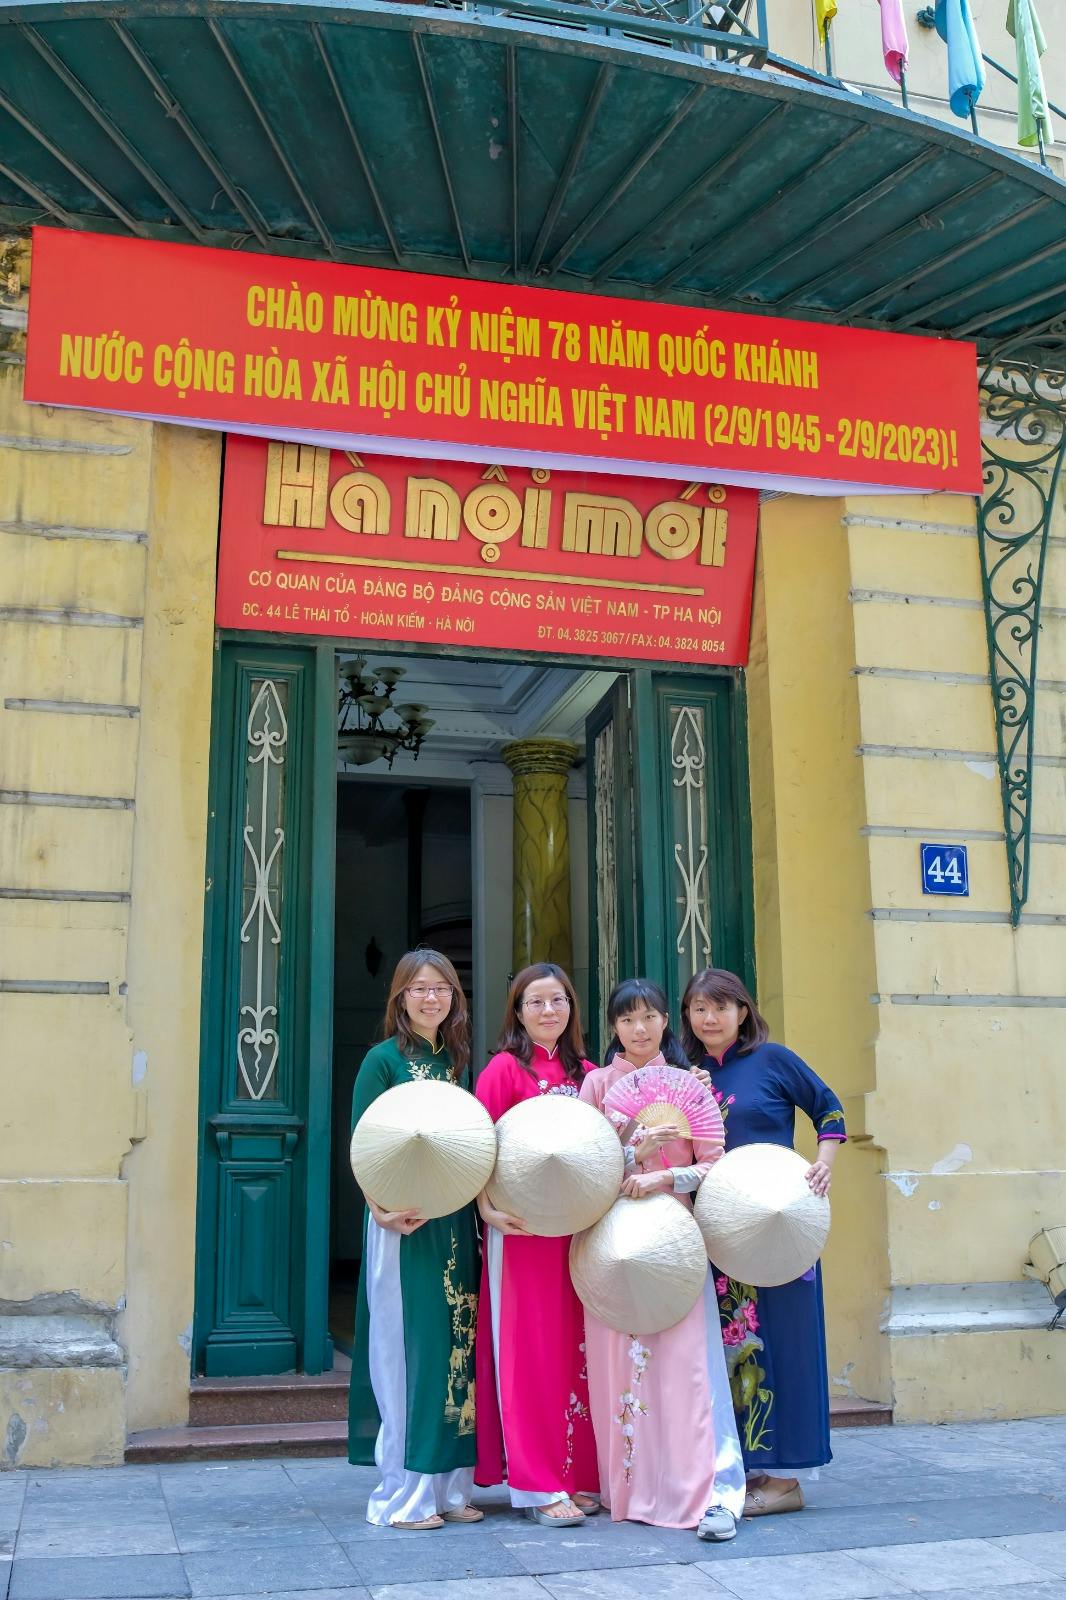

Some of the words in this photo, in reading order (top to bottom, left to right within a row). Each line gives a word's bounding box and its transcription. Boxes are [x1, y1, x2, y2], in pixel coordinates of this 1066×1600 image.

[246, 281, 323, 334] CHÀO
[333, 288, 417, 343] MỪNG
[427, 295, 463, 348] KỶ
[471, 306, 540, 363] NIỆM
[548, 321, 581, 362] 78
[590, 319, 650, 370] NĂM
[659, 325, 726, 379] QUỐC
[734, 339, 819, 389] KHÁNH
[60, 330, 144, 384] NƯỚC
[153, 338, 234, 398] CỘNG
[245, 346, 302, 400] HÒA
[312, 355, 350, 405] XÃ
[359, 360, 405, 418] HỘI
[415, 363, 470, 417] CHỦ
[480, 376, 563, 427] NGHĨA
[571, 384, 626, 440] VIỆT
[635, 395, 695, 440] NAM
[263, 441, 391, 536] Hà
[248, 570, 272, 587] CƠ
[276, 572, 320, 591] QUAN
[325, 572, 356, 594] CỦA
[413, 582, 435, 604] BỘ
[441, 582, 484, 605] ĐẢNG
[490, 588, 531, 610] CỘNG
[535, 590, 566, 612] SẢN
[570, 595, 602, 617] VIỆT
[606, 600, 639, 618] NAM
[653, 604, 671, 620] TP
[698, 606, 721, 628] NỘI
[266, 604, 281, 618] 44
[334, 603, 350, 623] TỔ
[573, 628, 598, 643] 3825
[675, 637, 699, 651] 3824
[701, 639, 725, 653] 8054
[927, 856, 962, 884] 44
